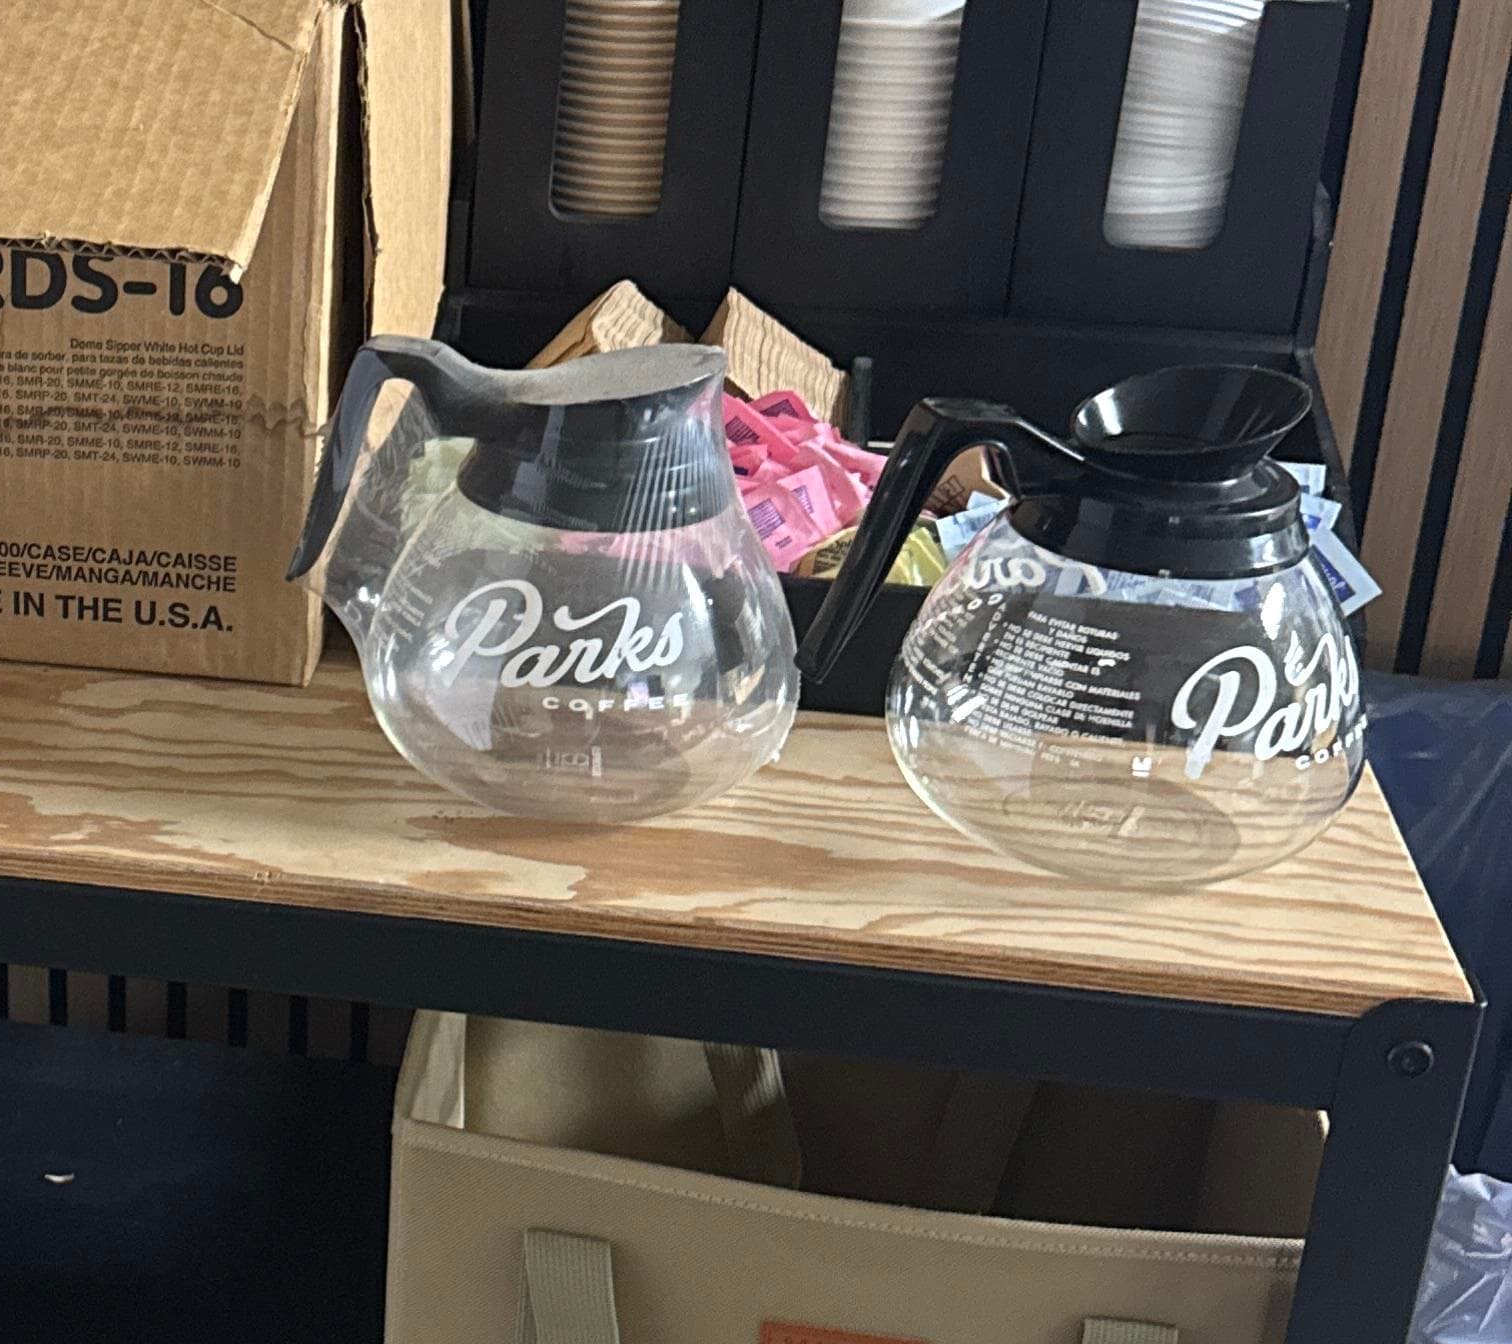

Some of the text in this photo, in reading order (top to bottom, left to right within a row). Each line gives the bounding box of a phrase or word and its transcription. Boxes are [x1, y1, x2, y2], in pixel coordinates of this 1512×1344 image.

[70, 338, 244, 356] Dome Sipper White Hot Cup Lid
[14, 349, 28, 359] de
[72, 354, 96, 363] para
[100, 353, 128, 363] tazas
[131, 354, 144, 364] de
[148, 355, 191, 366] bebidas
[194, 357, 243, 369] calientes
[8, 363, 36, 373] blanc
[39, 366, 63, 376] pour
[67, 365, 96, 377] petite
[140, 368, 153, 378] de
[156, 369, 198, 380] boisson
[201, 371, 243, 382] chaude
[13, 591, 44, 617] IN
[55, 595, 122, 623] THE
[134, 601, 233, 632] U.S.A.
[443, 579, 684, 688] Parks
[542, 693, 689, 712] COFFEE
